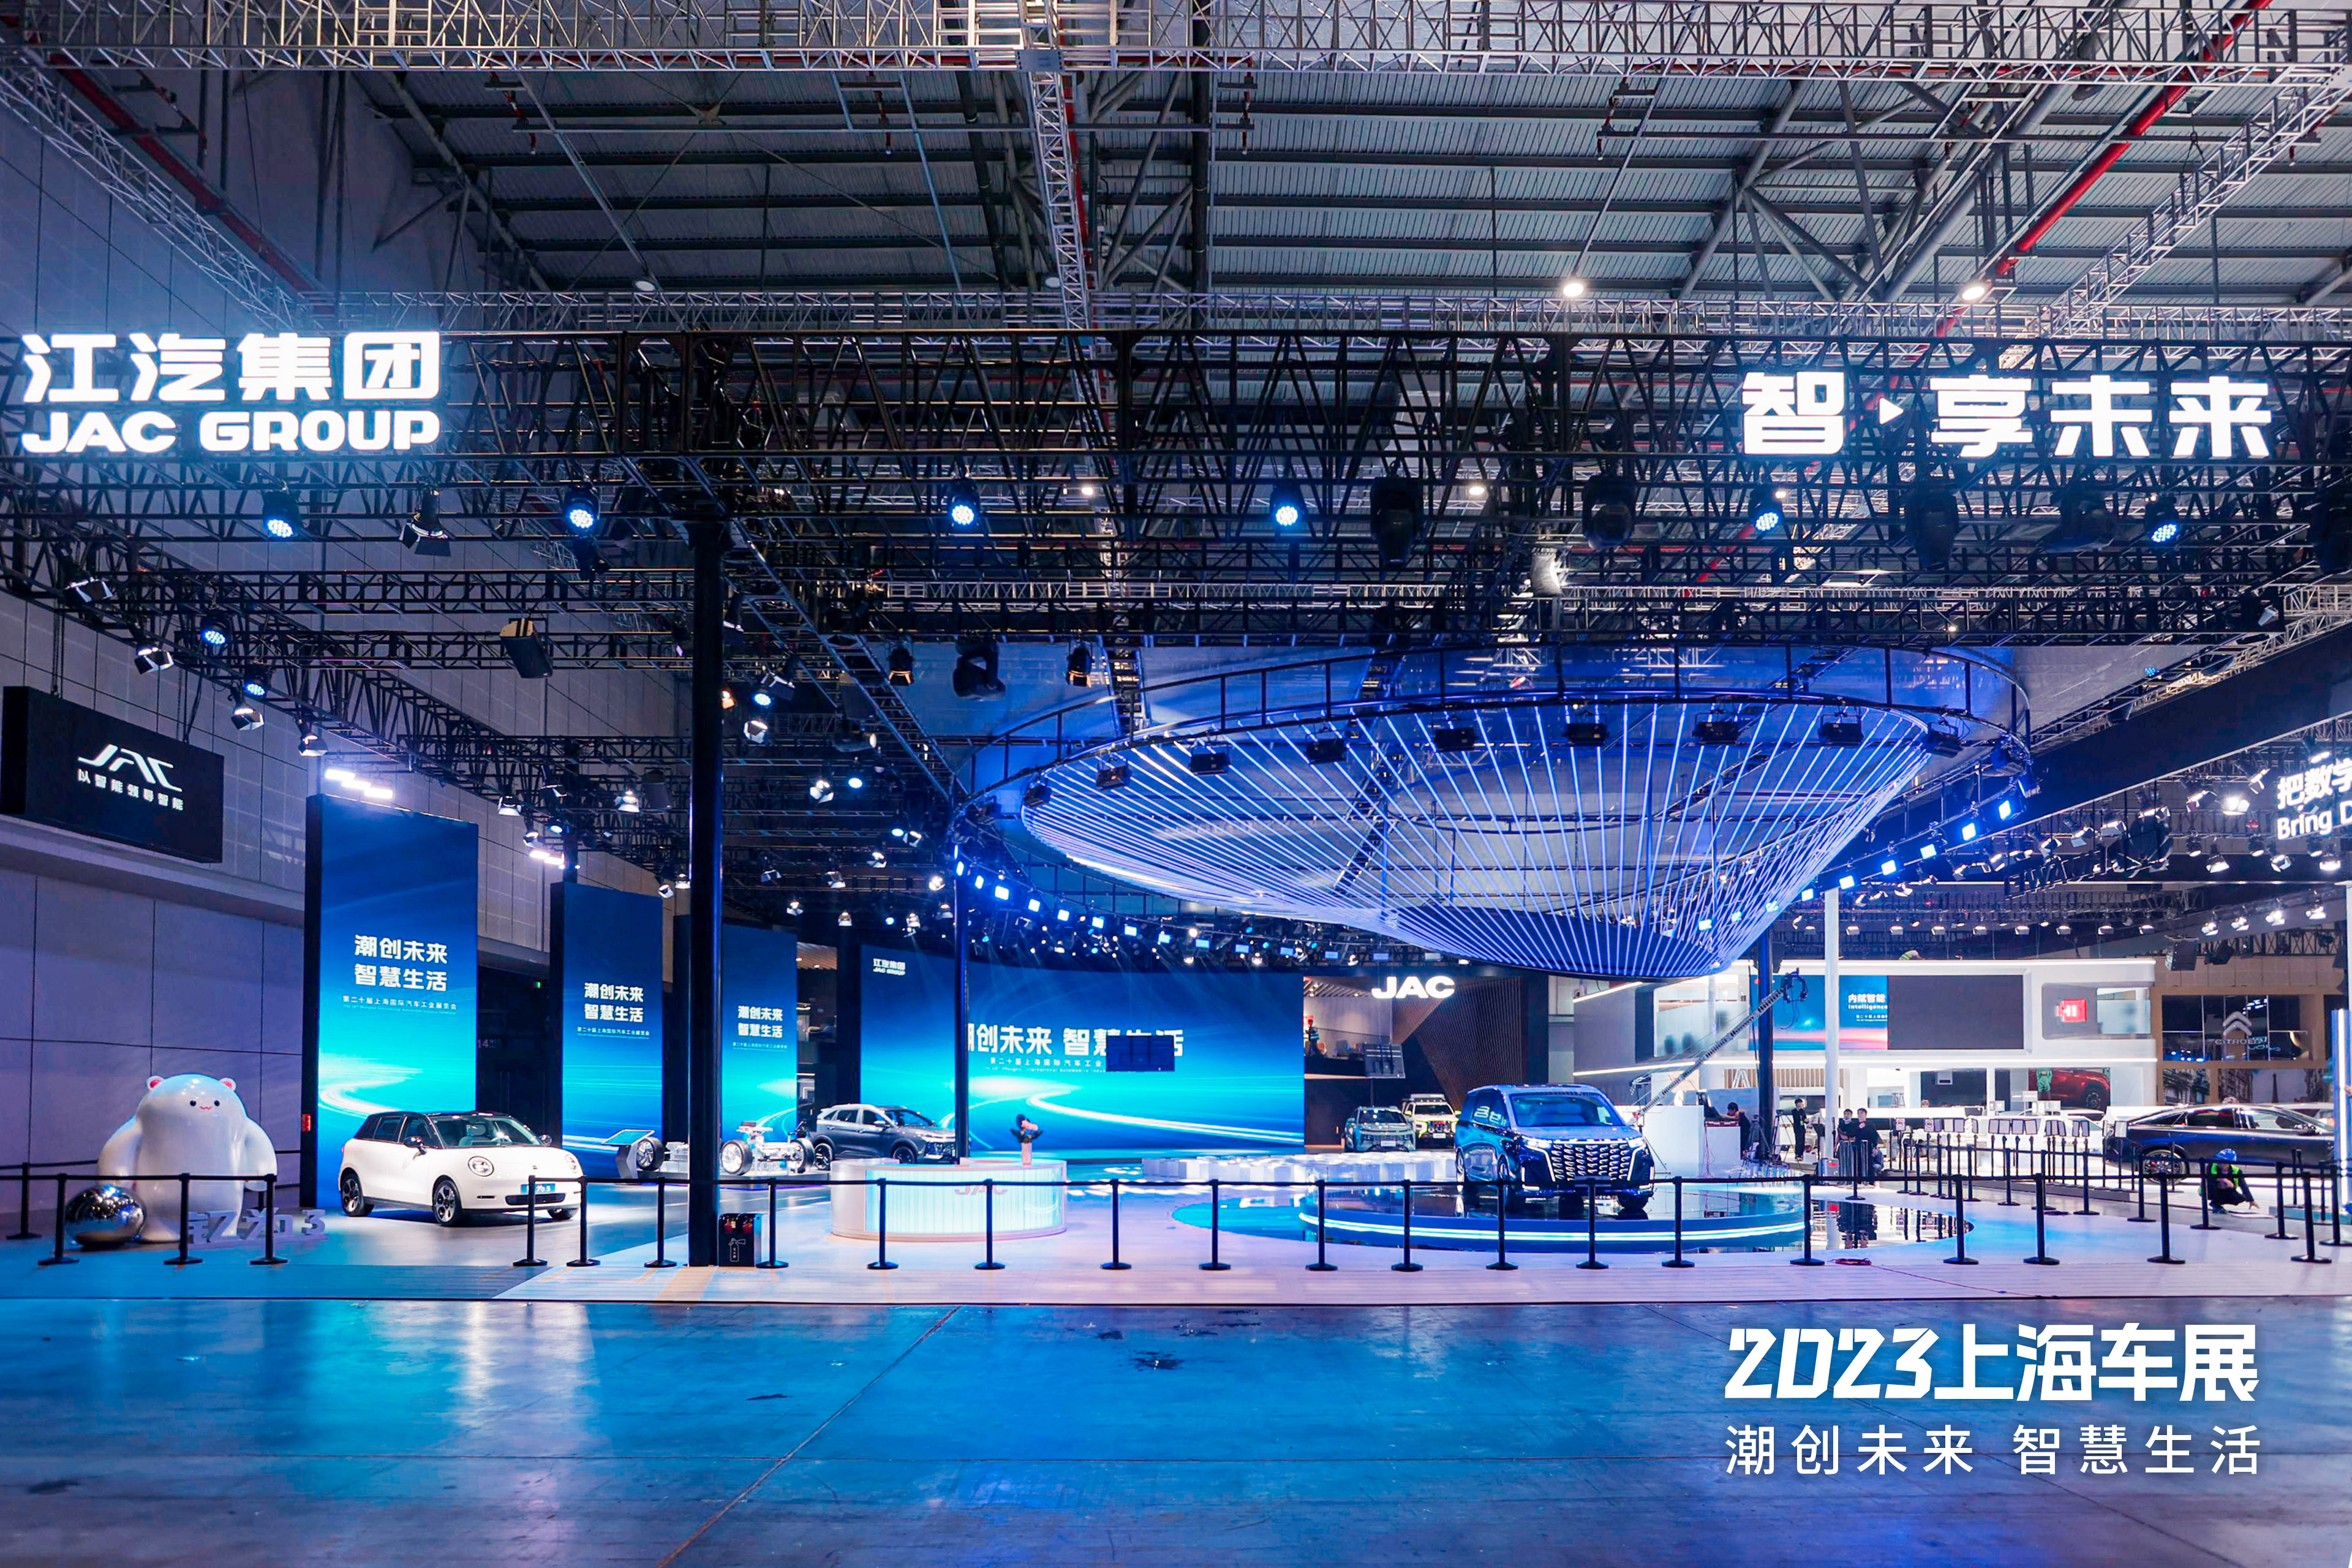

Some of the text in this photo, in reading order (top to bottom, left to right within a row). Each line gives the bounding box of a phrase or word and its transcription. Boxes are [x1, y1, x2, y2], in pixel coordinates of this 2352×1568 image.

[22, 332, 440, 402] 江汽集团
[22, 410, 440, 453] JAC GROUP
[78, 744, 183, 793] JAC
[77, 768, 184, 811] 以智能领导智能
[2277, 810, 2332, 840] Bring
[355, 935, 447, 965] 潮创未来
[355, 963, 447, 992] 智慧生活
[584, 982, 644, 1002] 潮创未来
[1371, 976, 1455, 998] JAC
[584, 1003, 644, 1022] 智慧生活
[737, 1005, 783, 1022] 潮创未来
[737, 1022, 783, 1038] 智慧生活
